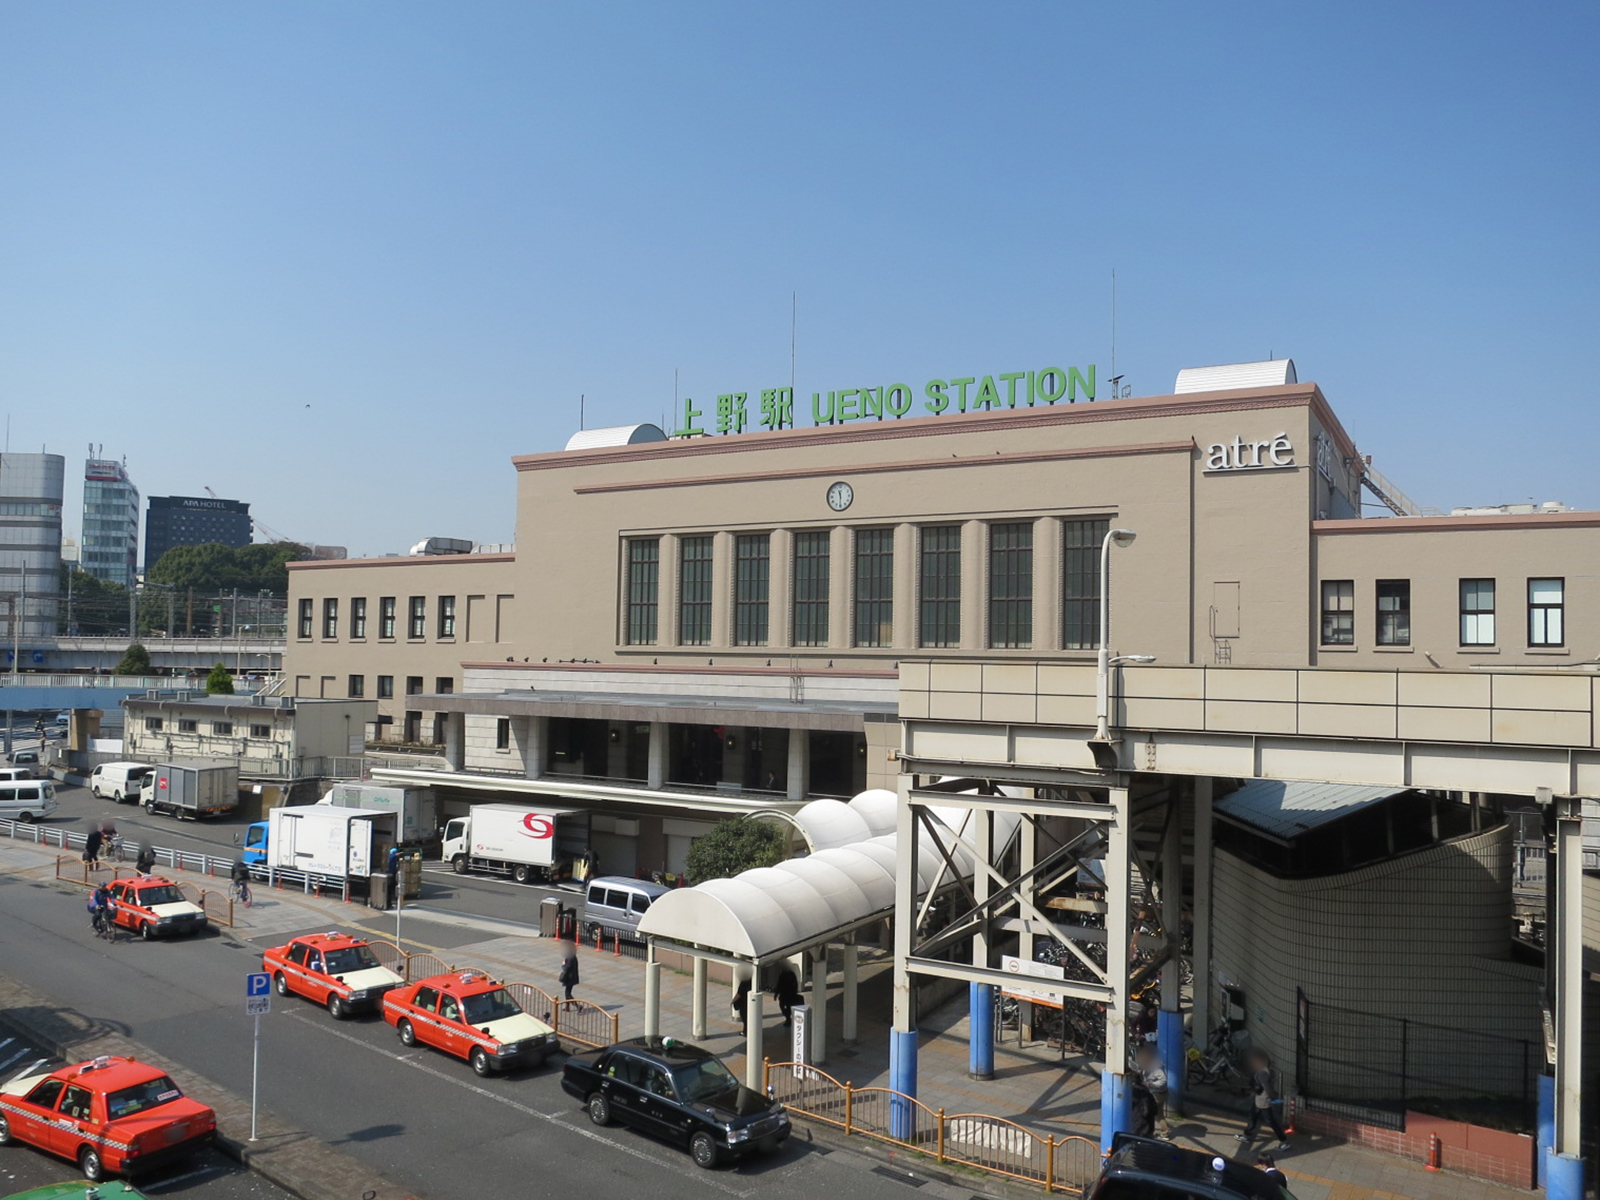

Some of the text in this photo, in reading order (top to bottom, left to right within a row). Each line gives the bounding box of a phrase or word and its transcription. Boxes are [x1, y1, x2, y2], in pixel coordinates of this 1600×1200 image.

[674, 387, 793, 436] 上野駅
[812, 364, 1096, 423] UENO STATION
[1206, 431, 1294, 469] atré
[183, 499, 226, 509] APA HOTEL
[252, 976, 267, 995] P
